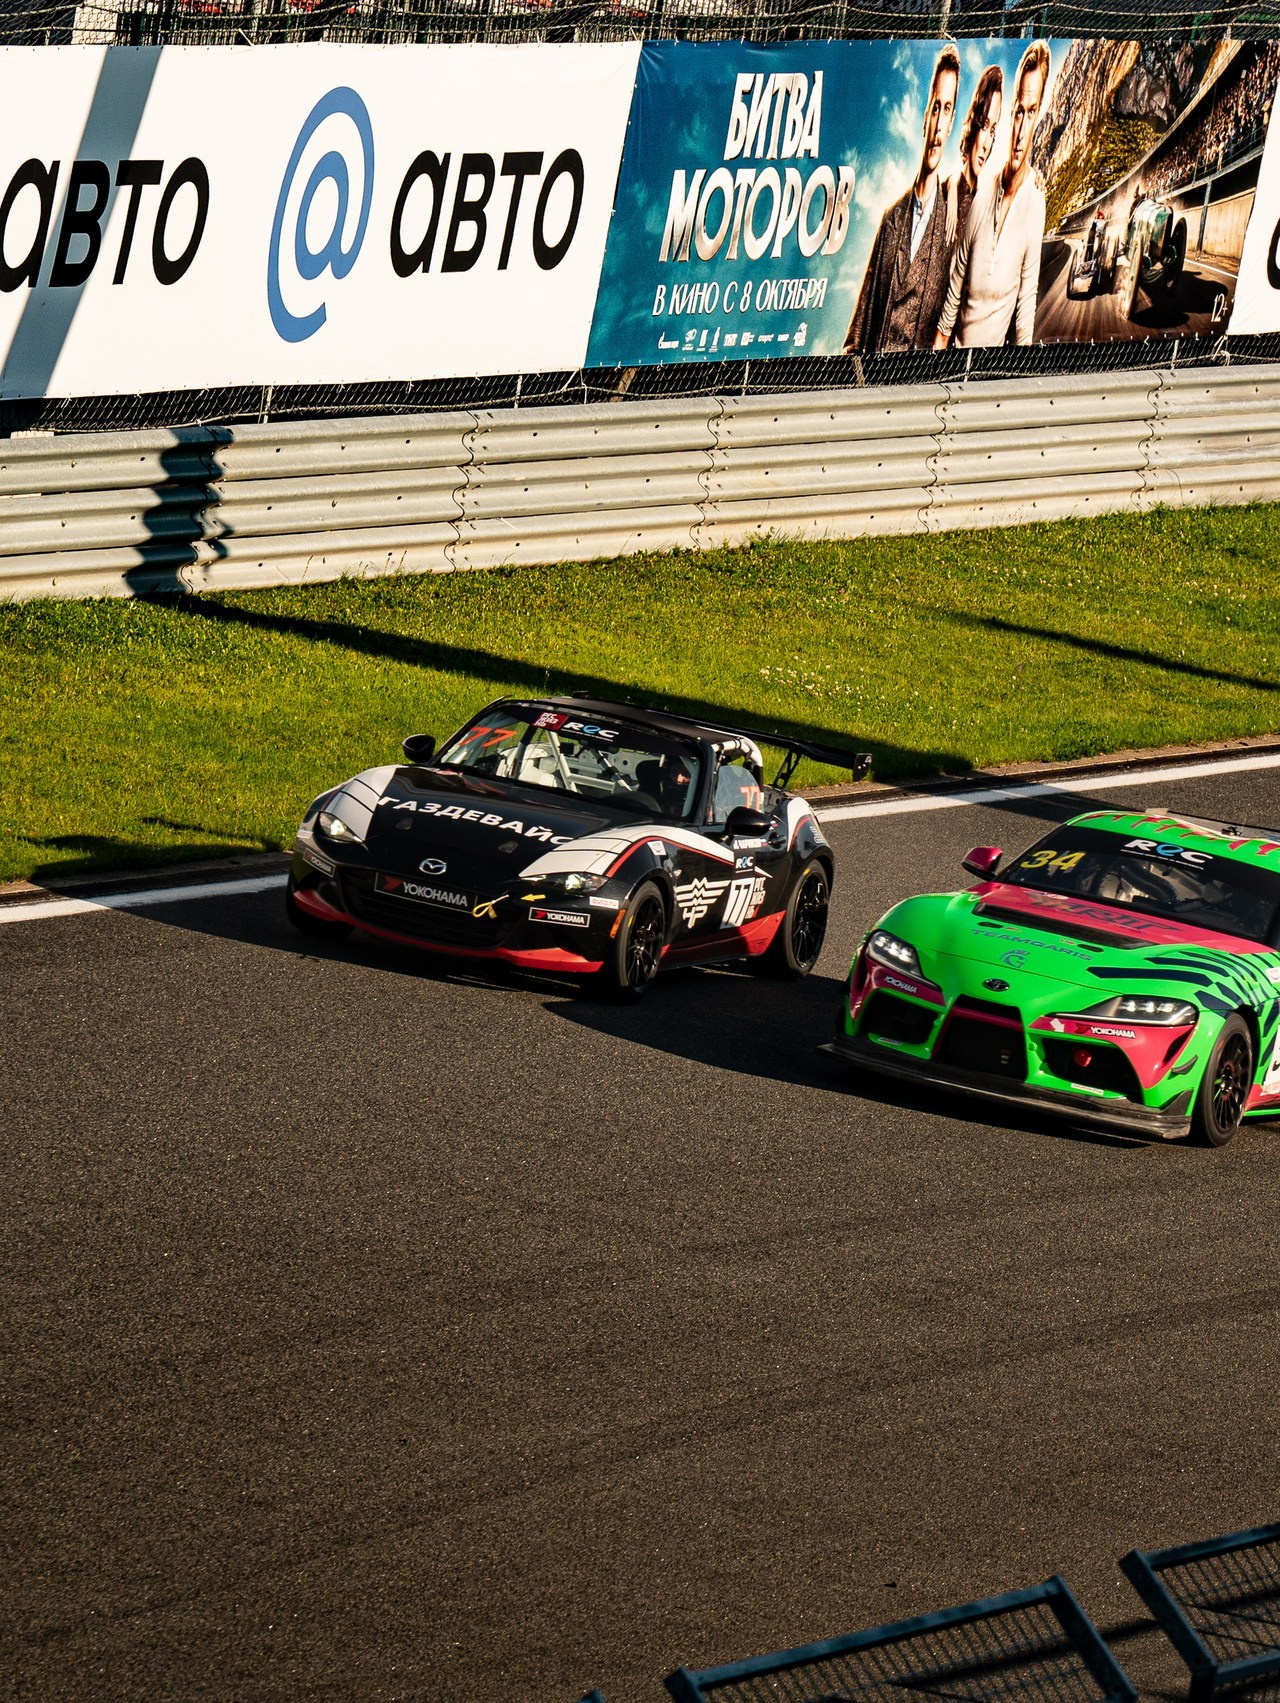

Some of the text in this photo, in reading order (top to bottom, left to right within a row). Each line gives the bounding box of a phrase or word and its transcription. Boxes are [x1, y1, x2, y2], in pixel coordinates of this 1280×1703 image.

[722, 70, 825, 161] БИТВА
[658, 165, 856, 263] МОТОРОВ
[652, 277, 829, 316] В КИНО С 8 ОКТЯБРЯ
[1211, 293, 1228, 322] 12+
[458, 726, 517, 748] 77
[740, 786, 760, 812] 77
[377, 796, 574, 846] ГАЗДЕВАЙС
[1020, 850, 1087, 870] 34
[403, 883, 468, 907] YOKOHAMA
[546, 913, 585, 924] YOKOHAMA
[884, 975, 918, 994] YOKOHAMA
[1091, 1026, 1136, 1039] YOKOHAMA
